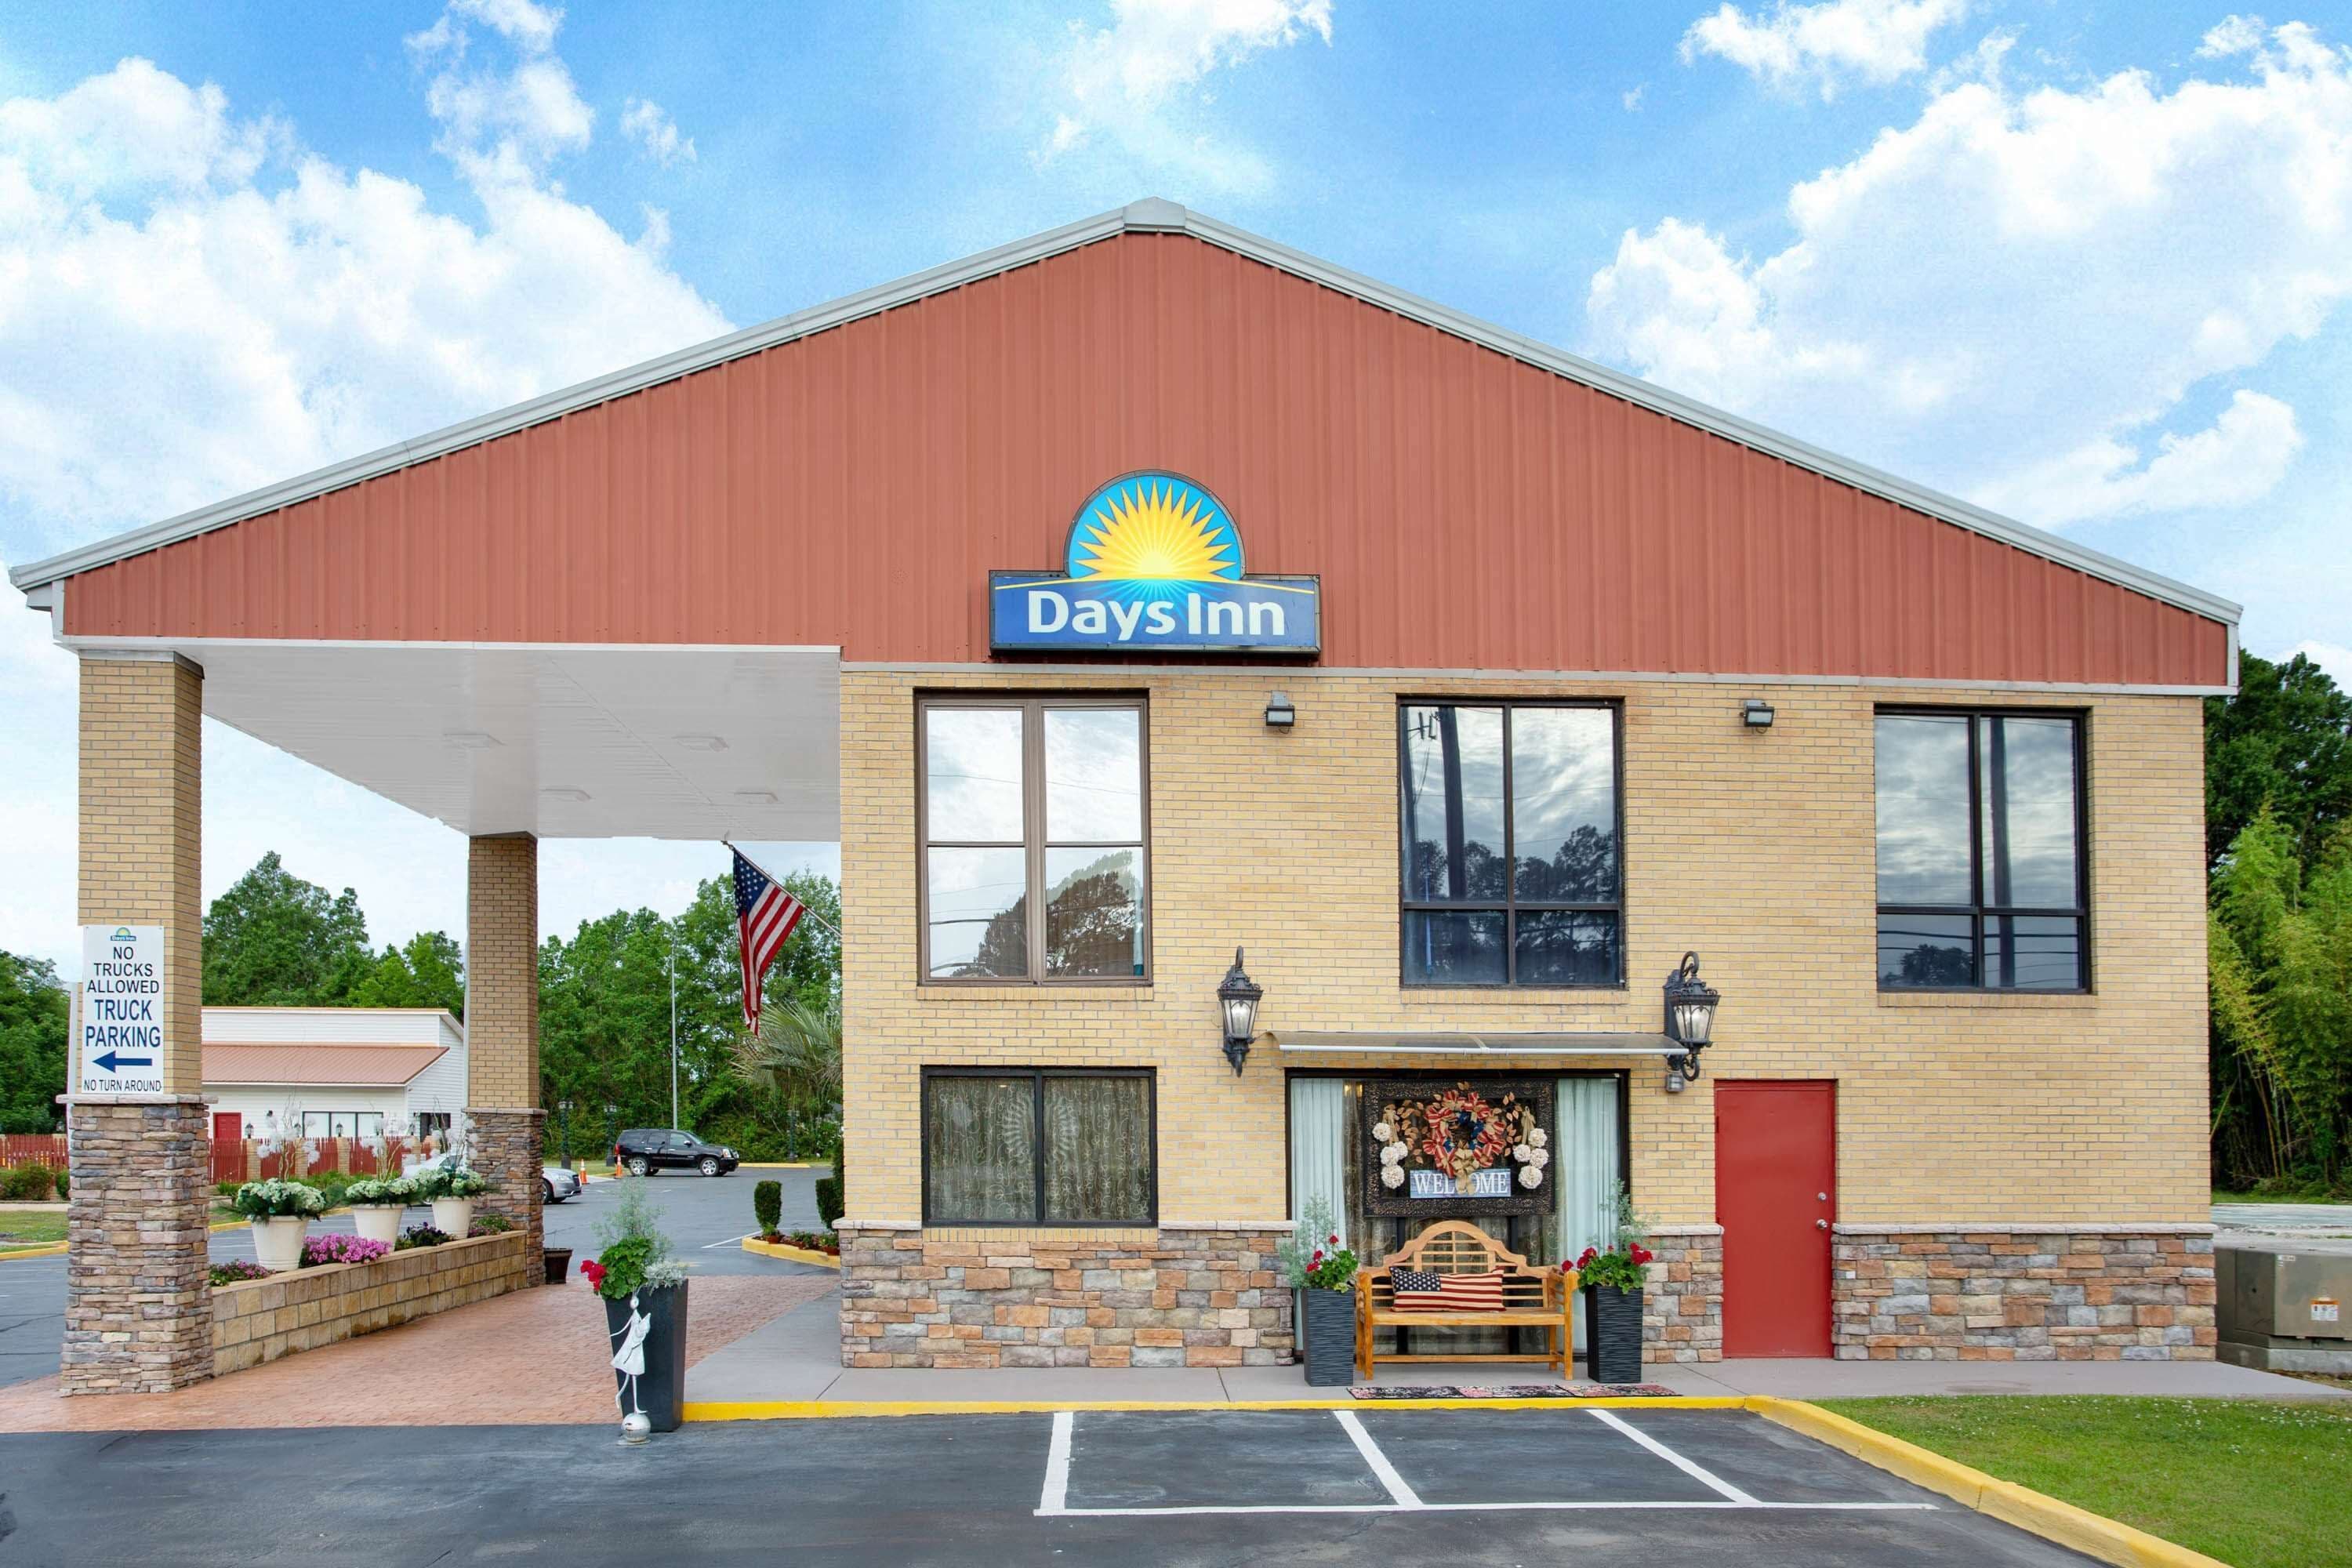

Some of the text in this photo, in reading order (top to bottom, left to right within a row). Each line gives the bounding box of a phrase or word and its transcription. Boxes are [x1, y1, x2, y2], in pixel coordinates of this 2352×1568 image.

[1028, 590, 1285, 641] Days Inn
[113, 946, 134, 960] NO
[93, 963, 153, 977] TRUCKS
[87, 979, 159, 993] ALLOWED
[94, 999, 152, 1021] TRUCK
[85, 1025, 161, 1047] PARKING
[84, 1079, 161, 1092] NO TURN AROUND
